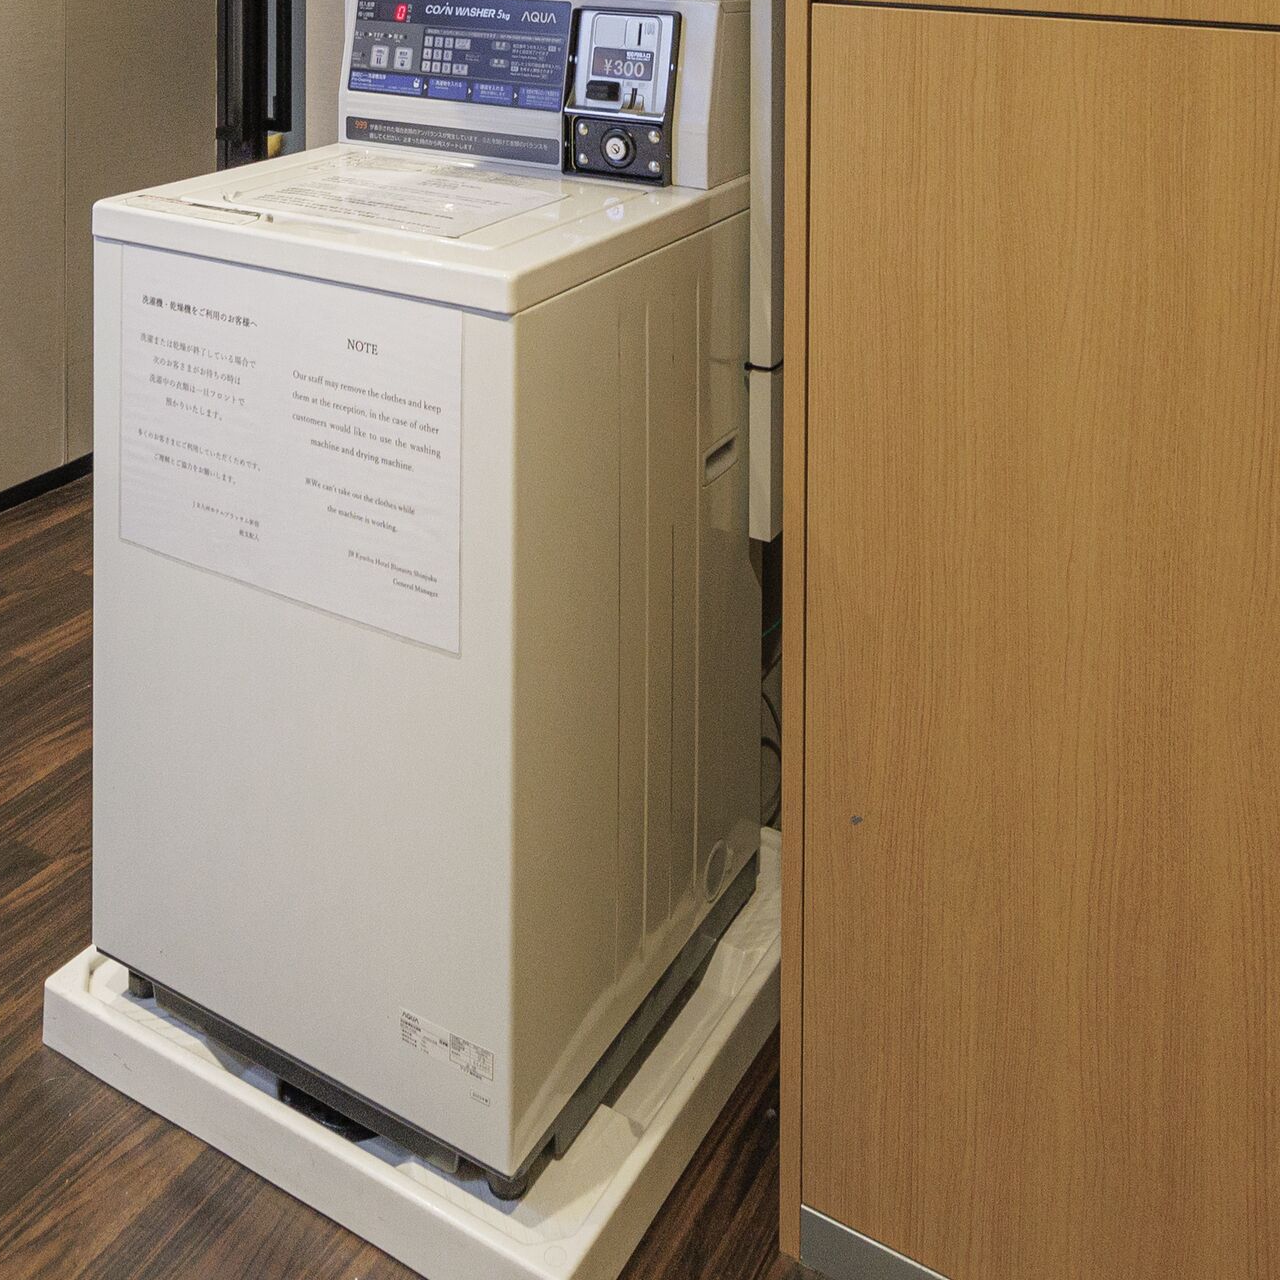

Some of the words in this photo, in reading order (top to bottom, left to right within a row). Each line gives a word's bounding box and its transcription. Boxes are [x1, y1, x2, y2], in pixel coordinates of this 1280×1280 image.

[397, 5, 406, 20] 0
[425, 2, 453, 16] COIN
[455, 6, 496, 19] WASHER
[496, 9, 511, 21] 5kg
[521, 11, 557, 24] AQUA
[603, 59, 645, 77] ¥300
[347, 338, 378, 356] NOTE
[293, 370, 306, 381] Our
[308, 375, 323, 385] staff
[325, 379, 339, 391] may
[340, 383, 366, 396] remove
[368, 388, 379, 399] the
[381, 391, 406, 406] clothes
[408, 399, 422, 409] and
[423, 400, 441, 414] keep
[292, 391, 310, 403] them
[320, 398, 331, 408] the
[370, 410, 377, 420] in
[378, 412, 390, 424] the
[392, 416, 407, 426] case
[409, 420, 418, 430] of
[419, 423, 439, 435] other
[292, 413, 327, 428] customers
[329, 422, 351, 434] would
[354, 426, 367, 437] like
[370, 432, 377, 441] to
[380, 435, 392, 444] use
[395, 437, 407, 448] the
[410, 442, 441, 459] washing
[310, 437, 339, 452] machine
[341, 445, 355, 456] and
[356, 448, 380, 464] drying
[381, 455, 414, 472] machine.
[338, 487, 350, 497] take
[352, 492, 362, 500] out
[364, 493, 373, 504] the
[375, 497, 397, 511] clothes
[398, 503, 415, 515] while
[327, 505, 337, 514] the
[338, 508, 363, 522] machine
[365, 516, 370, 524] is
